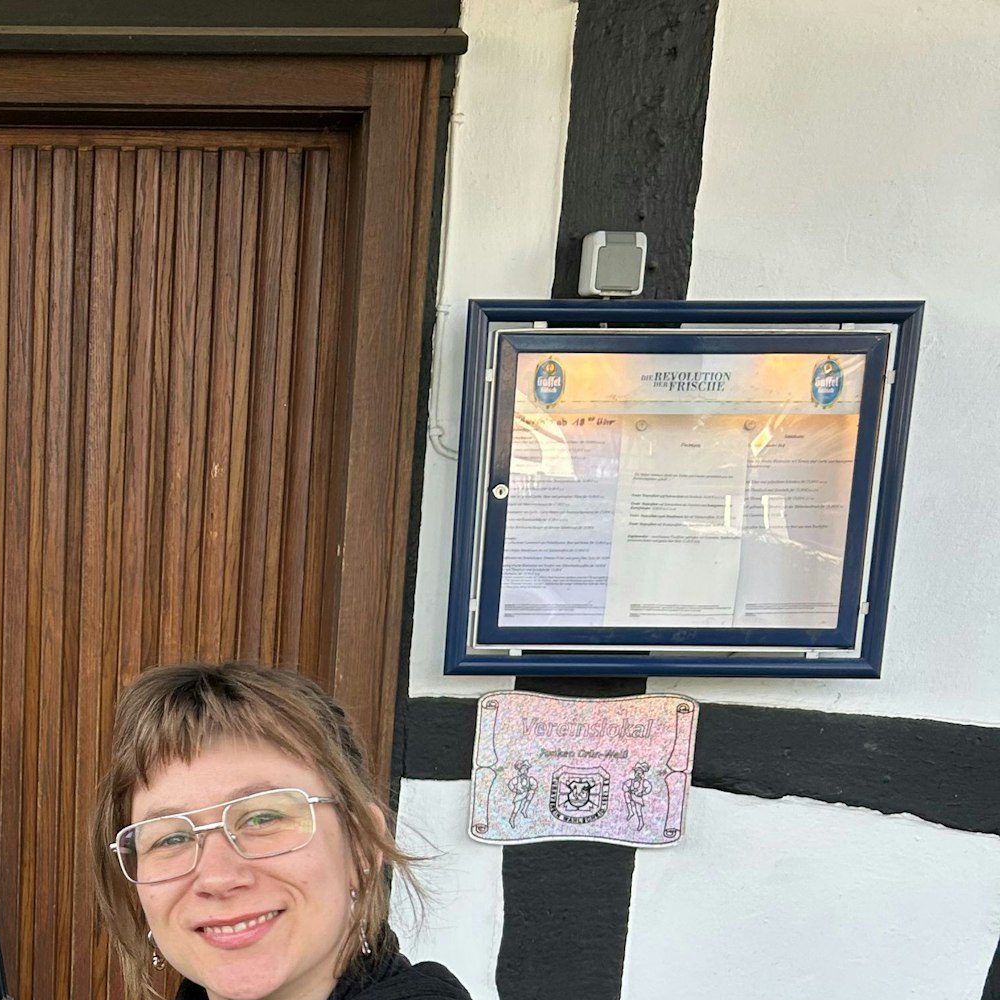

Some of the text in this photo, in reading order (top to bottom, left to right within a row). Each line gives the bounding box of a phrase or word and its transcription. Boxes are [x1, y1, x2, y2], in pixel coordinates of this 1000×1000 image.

[537, 375, 561, 388] Gaffel
[654, 371, 731, 381] REVOLUTION
[815, 376, 839, 388] Gaffel
[668, 381, 725, 392] FRISCHE
[521, 716, 655, 739] Vereinslokal
